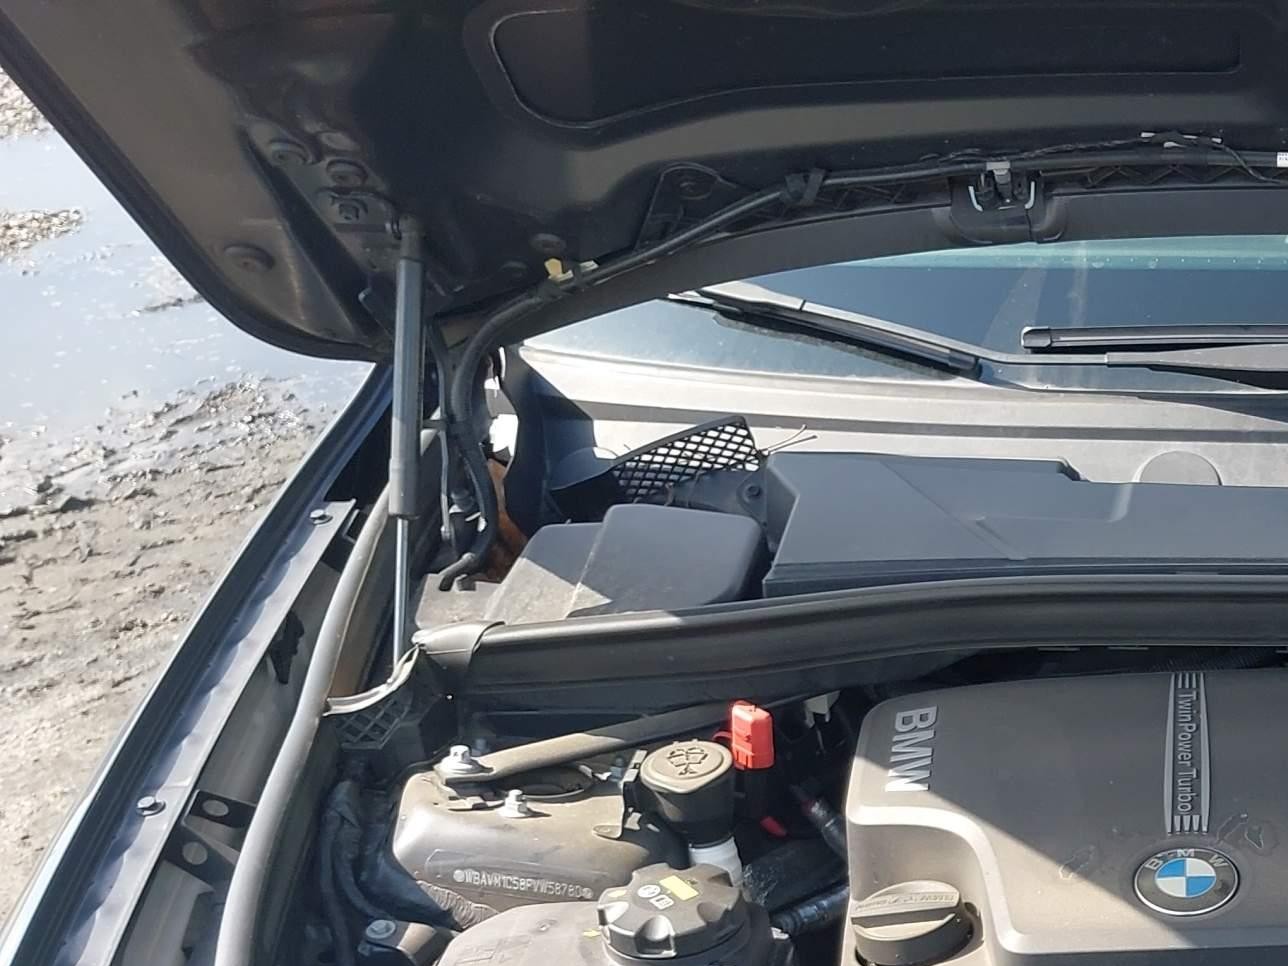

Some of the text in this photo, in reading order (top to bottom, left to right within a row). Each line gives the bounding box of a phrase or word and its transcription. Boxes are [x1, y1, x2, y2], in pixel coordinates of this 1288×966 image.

[884, 705, 938, 792] BMW
[1176, 690, 1198, 813] TwinPower Turbo
[1144, 847, 1230, 871] BMW
